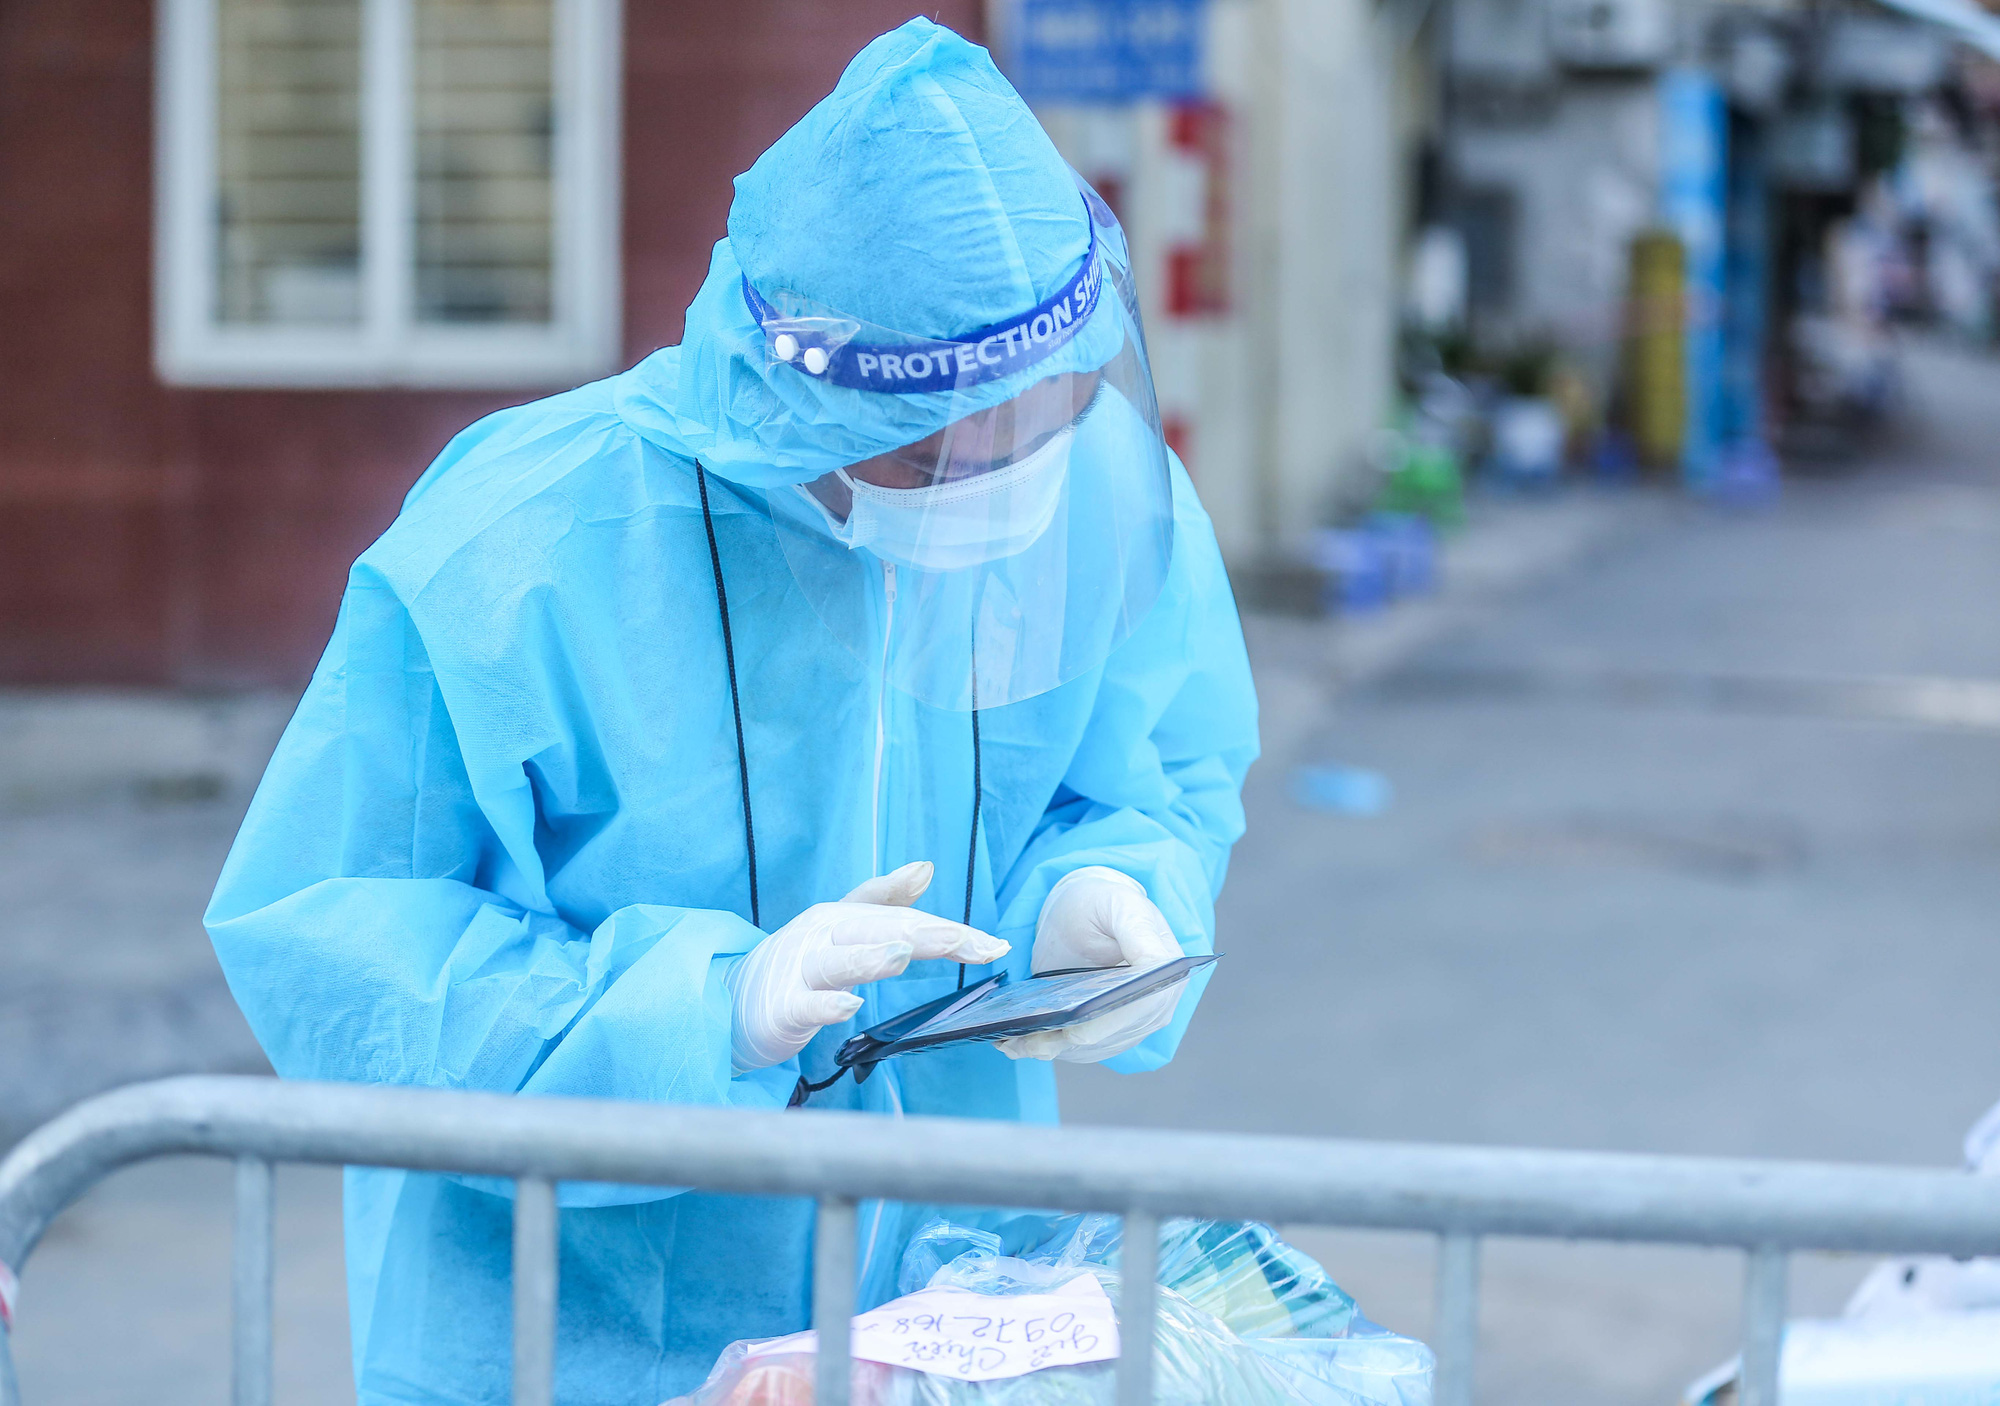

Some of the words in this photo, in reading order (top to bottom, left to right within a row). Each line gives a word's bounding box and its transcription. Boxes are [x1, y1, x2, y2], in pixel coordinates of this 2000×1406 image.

[857, 296, 1073, 380] PROTECTION
[892, 1313, 944, 1335] 168
[953, 1312, 1075, 1344] 0972
